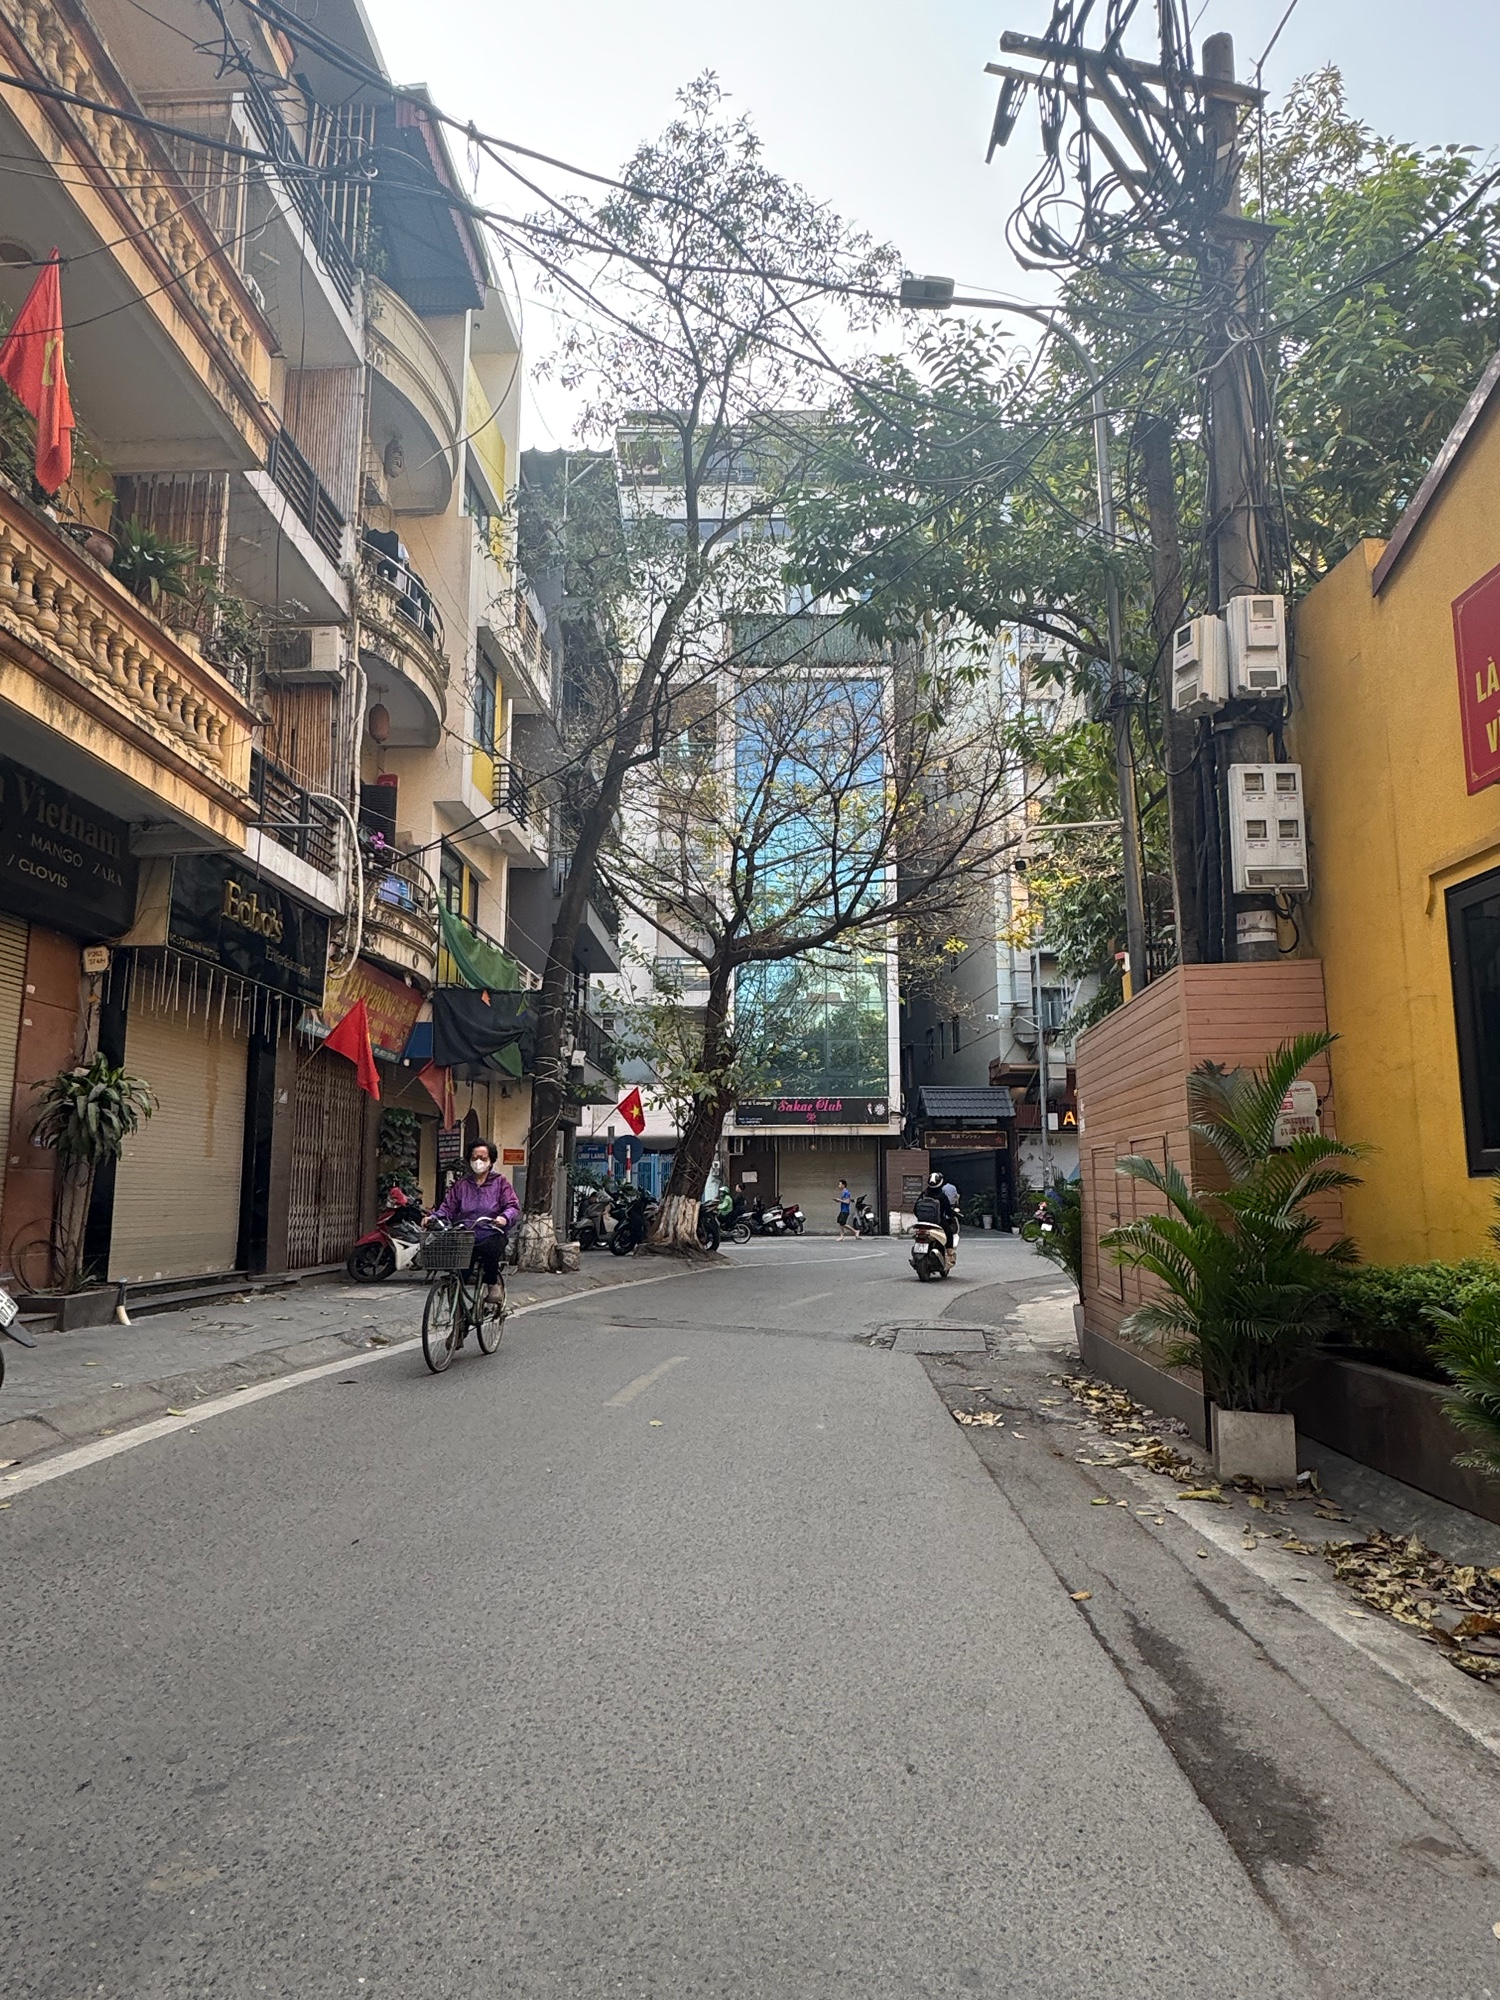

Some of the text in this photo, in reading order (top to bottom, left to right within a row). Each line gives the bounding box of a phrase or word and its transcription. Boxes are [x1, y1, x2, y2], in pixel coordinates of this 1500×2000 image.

[15, 773, 120, 859] Vietnam
[31, 832, 84, 868] MANGO
[18, 857, 69, 889] CLOVIS
[221, 878, 284, 944] Echo's
[777, 1098, 843, 1112] Sakae Club
